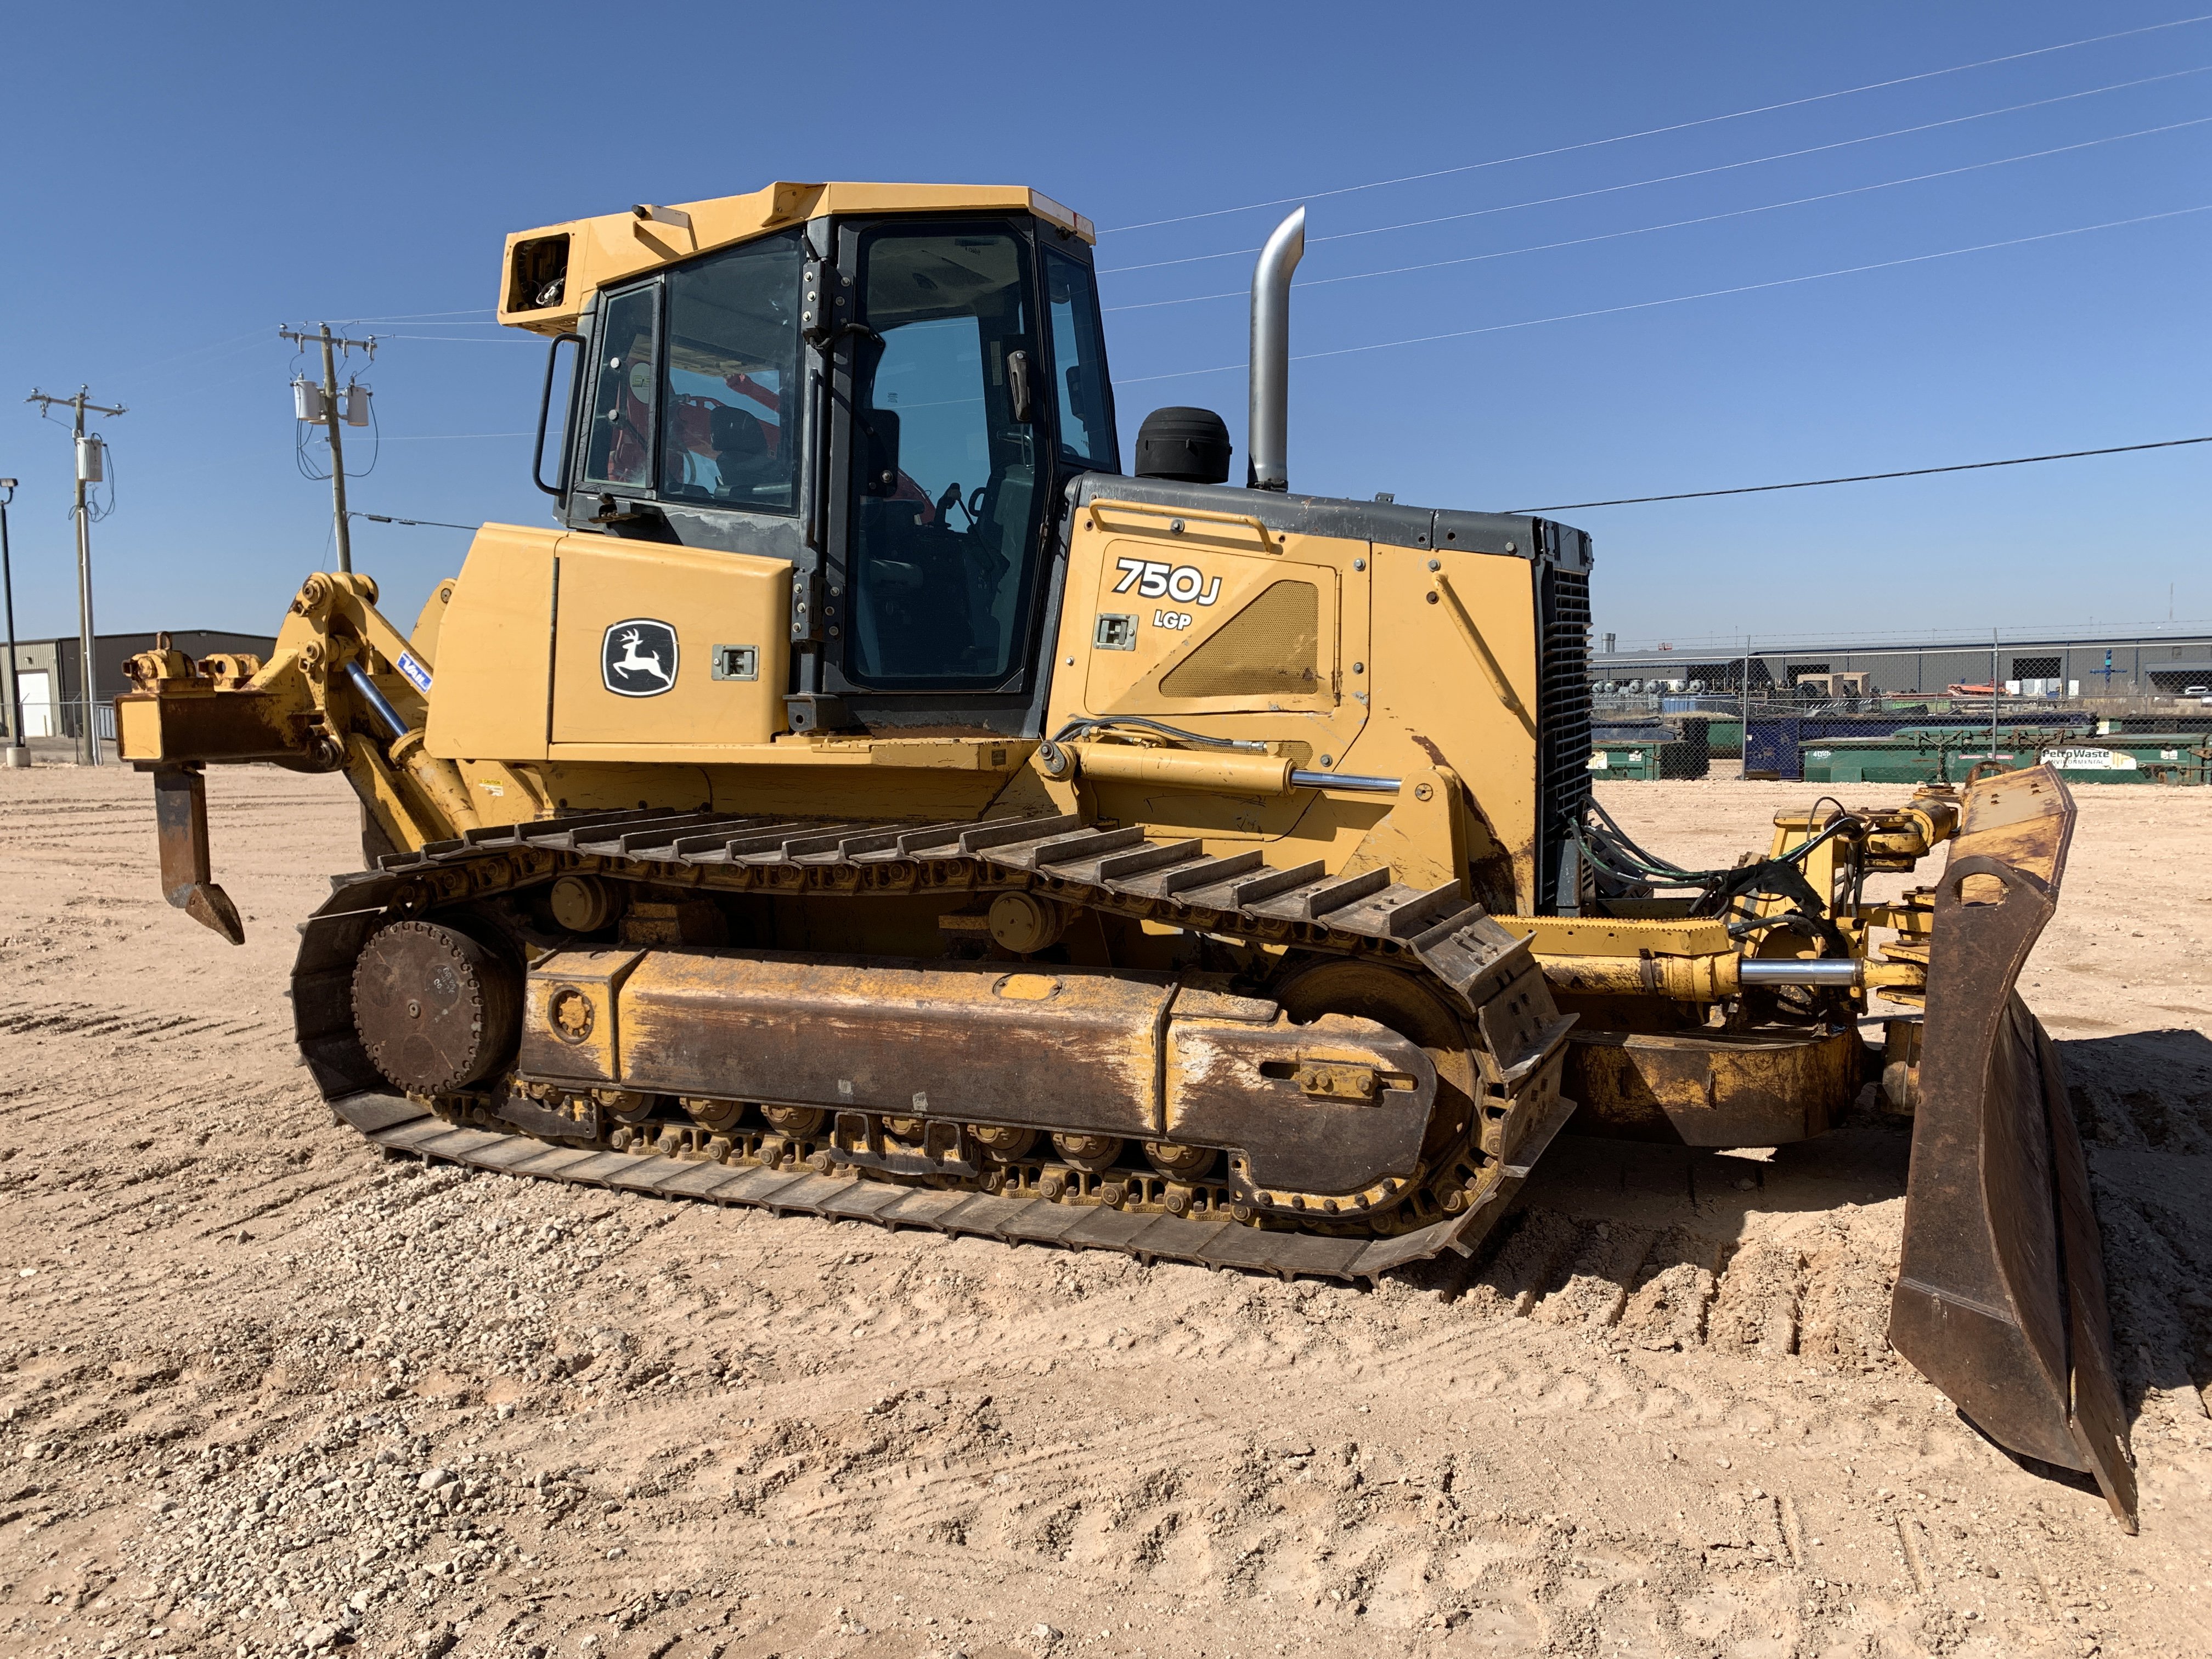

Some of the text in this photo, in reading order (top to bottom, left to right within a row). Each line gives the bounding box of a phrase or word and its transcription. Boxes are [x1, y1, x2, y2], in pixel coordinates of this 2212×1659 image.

[1111, 557, 1222, 606] 750J
[1152, 609, 1192, 631] LGP
[402, 654, 426, 690] VAIL
